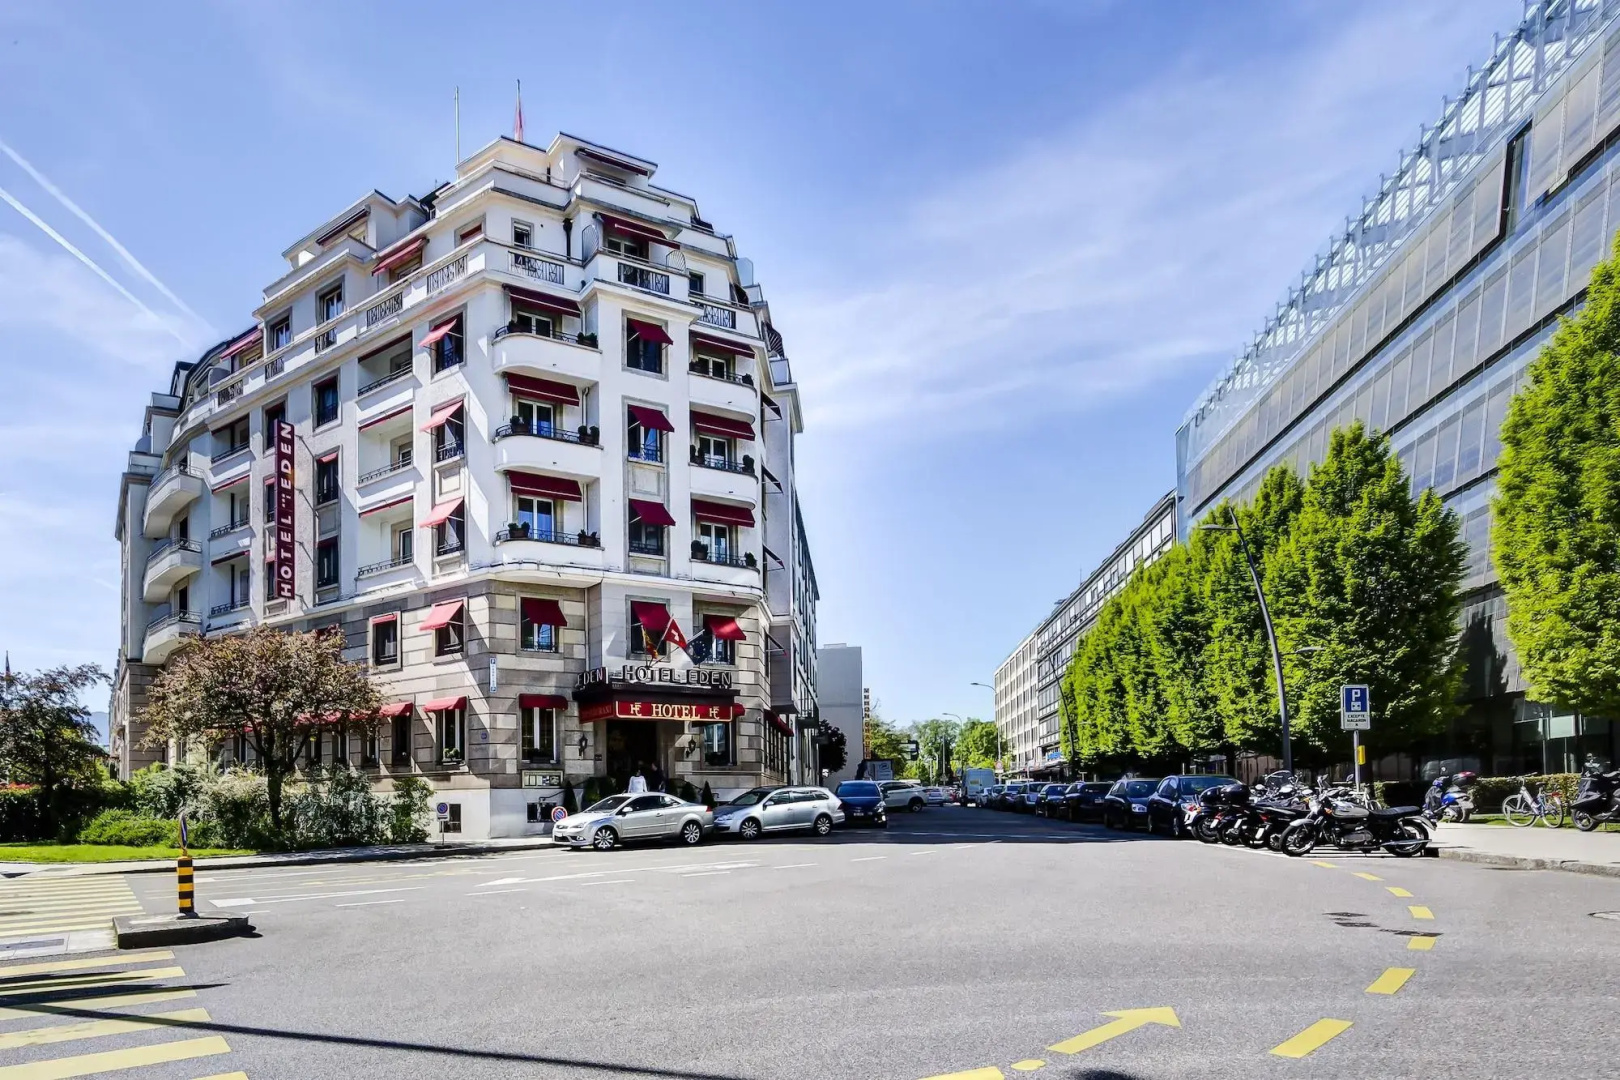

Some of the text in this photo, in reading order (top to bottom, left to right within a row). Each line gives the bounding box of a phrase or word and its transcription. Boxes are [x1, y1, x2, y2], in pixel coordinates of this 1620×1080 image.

[280, 422, 292, 598] HOTEL EDEN
[623, 665, 732, 685] HOTEL EDEN
[1352, 689, 1360, 701] P
[651, 703, 700, 719] HOTEL
